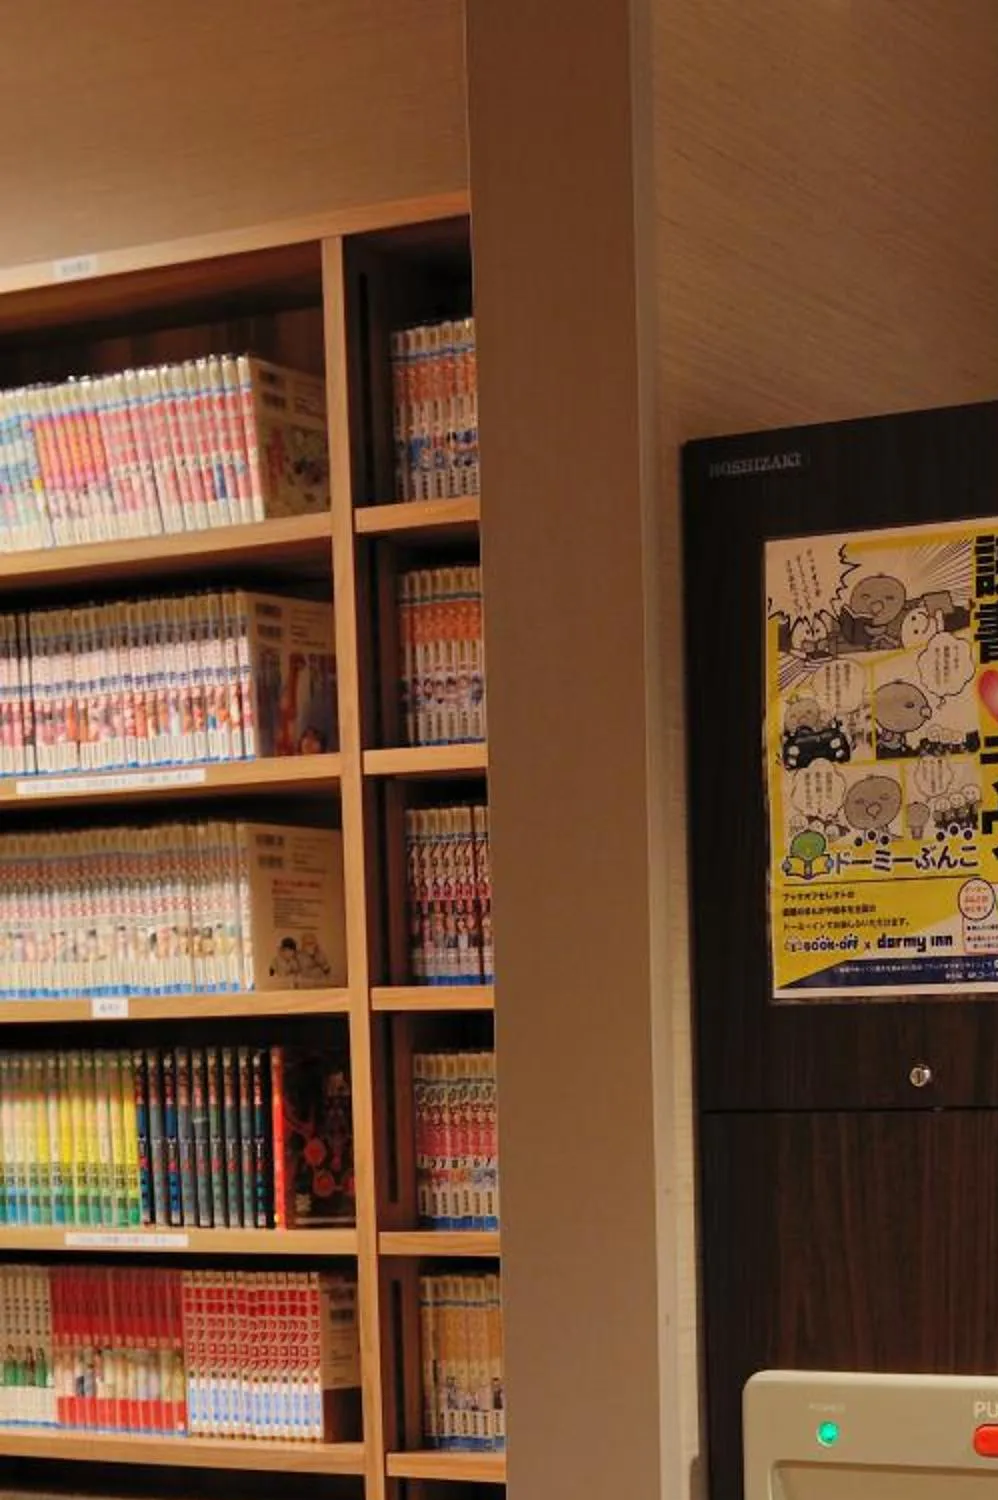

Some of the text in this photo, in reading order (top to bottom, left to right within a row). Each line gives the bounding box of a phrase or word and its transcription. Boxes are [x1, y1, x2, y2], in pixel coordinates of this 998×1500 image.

[836, 845, 980, 873] ドーミーぶんこ
[877, 933, 927, 952] dormy
[931, 935, 953, 947] inn
